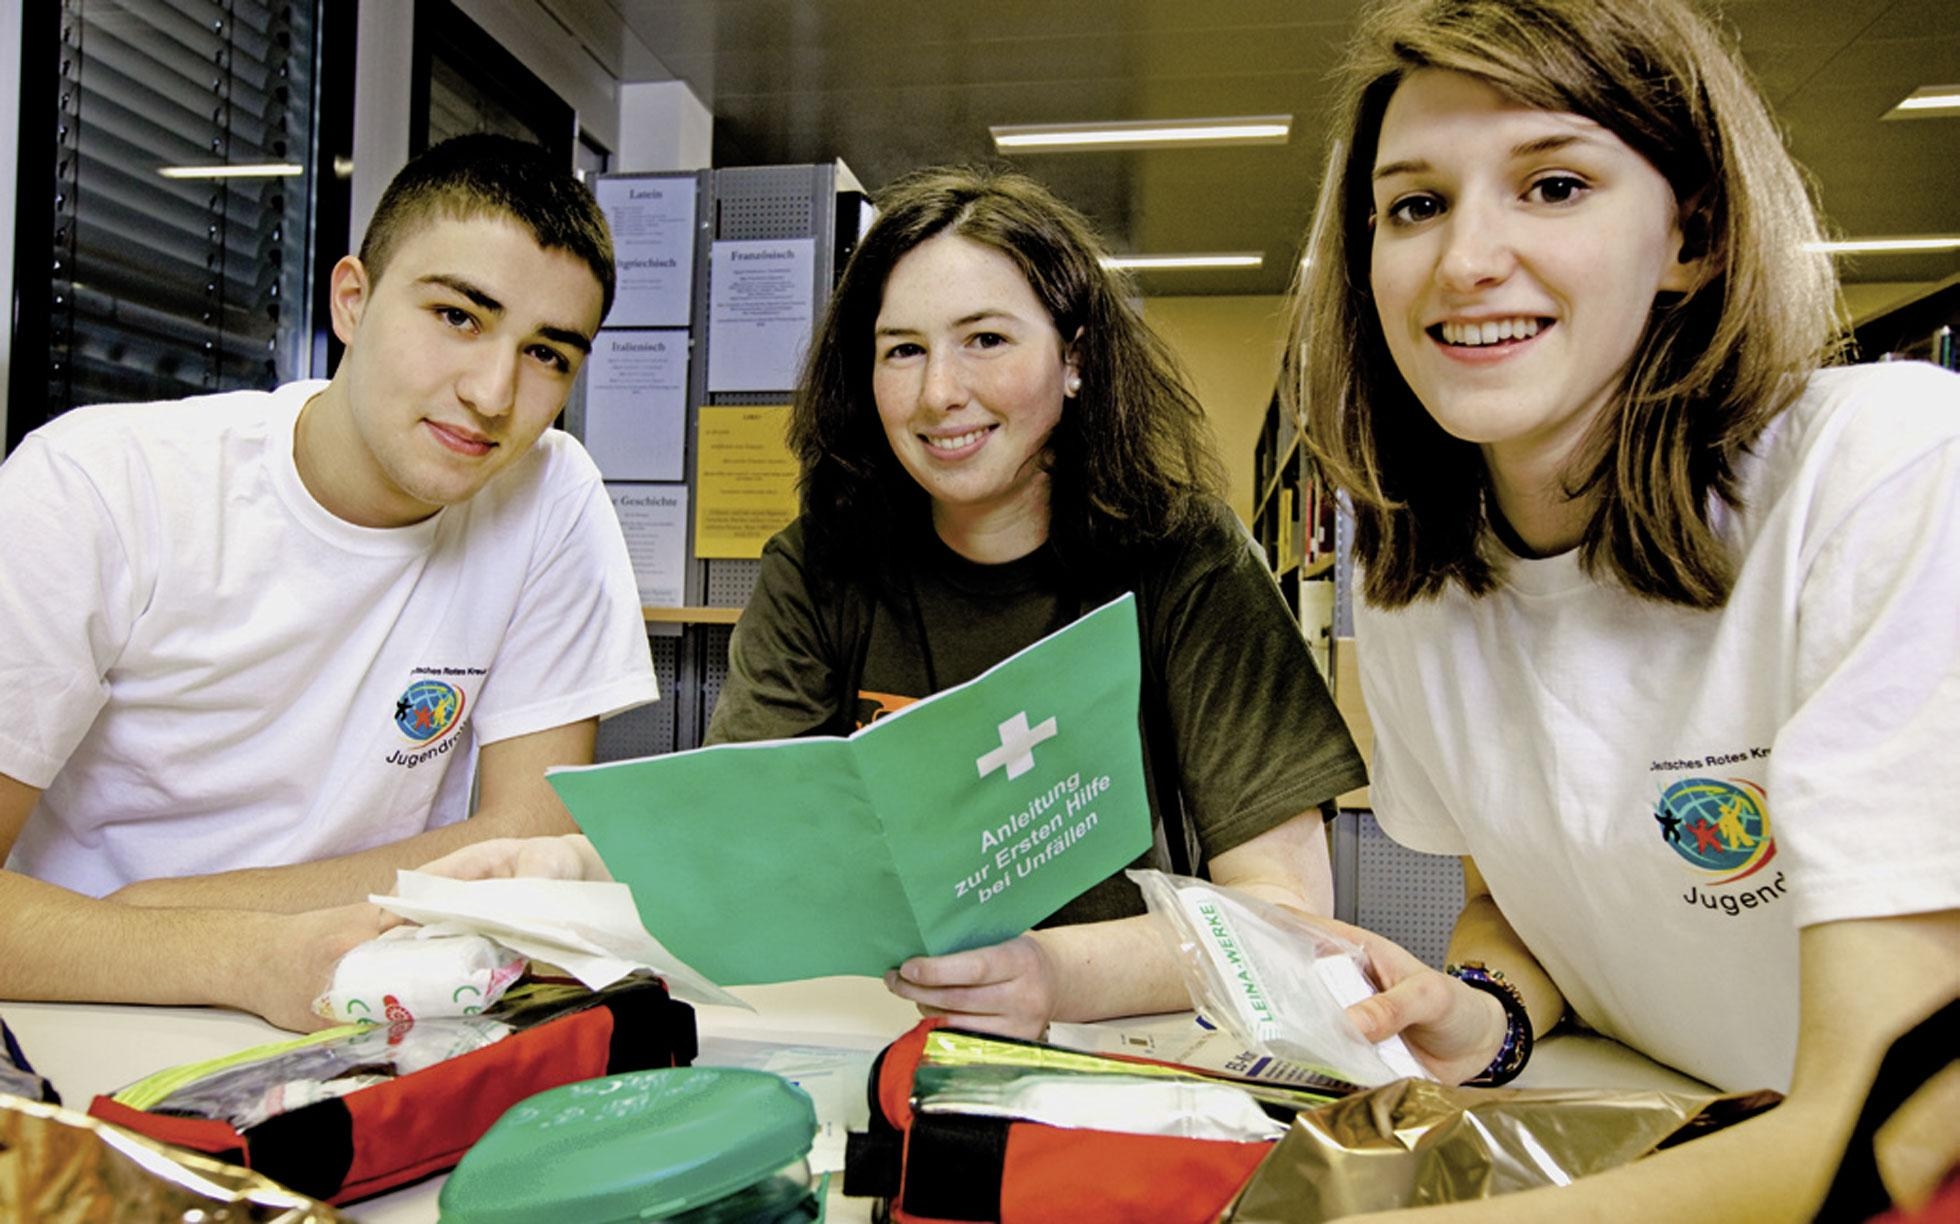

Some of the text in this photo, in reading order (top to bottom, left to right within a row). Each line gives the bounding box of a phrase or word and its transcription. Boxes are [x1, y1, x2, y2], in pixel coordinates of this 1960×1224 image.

[629, 189, 664, 200] Latein
[730, 249, 796, 262] Französisch
[611, 341, 667, 352] Italienisch
[620, 495, 678, 507] Geschichte
[443, 666, 466, 676] Rotes
[1705, 752, 1748, 768] Rotes
[980, 772, 1082, 854] Anleitung
[954, 774, 1111, 898] zur Ersten Hilfe
[978, 811, 1098, 904] bei Unfällen
[1199, 903, 1275, 1022] LEINA-WERKE
